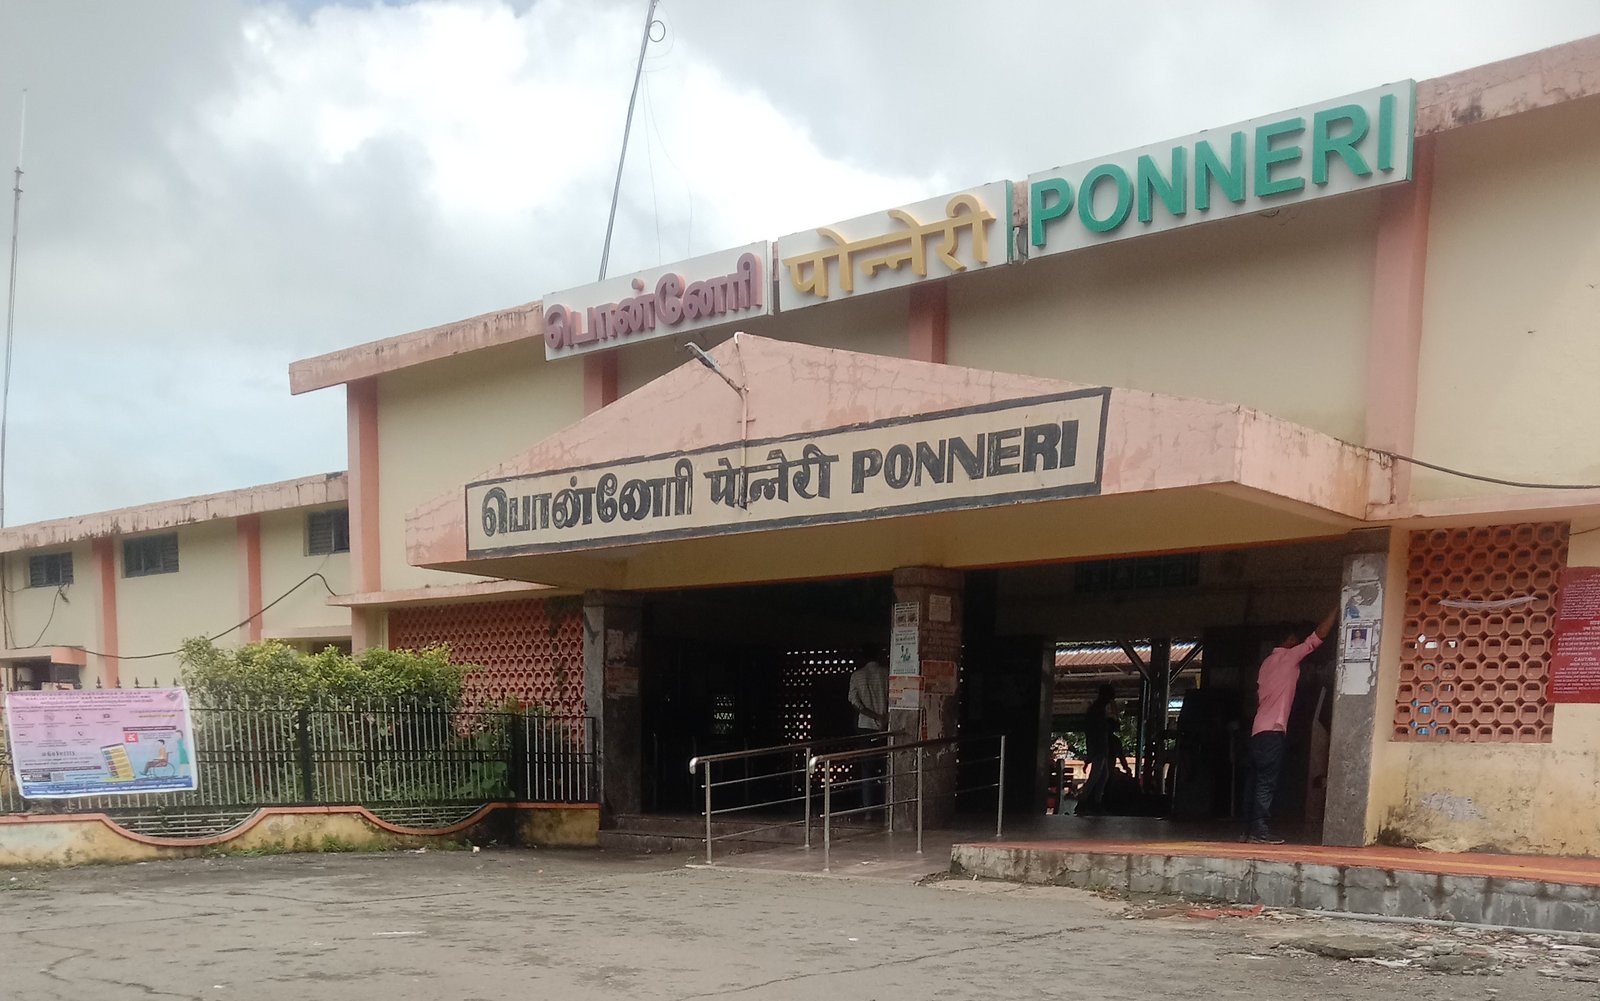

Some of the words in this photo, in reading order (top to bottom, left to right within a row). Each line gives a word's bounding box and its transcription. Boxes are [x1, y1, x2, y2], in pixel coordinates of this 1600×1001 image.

[1030, 93, 1397, 248] PONNERI
[544, 252, 762, 349] பொன்னேரி
[782, 193, 996, 298] पोन्नेरी
[481, 457, 693, 537] பொன்னேரி
[851, 419, 1079, 494] PONNERI
